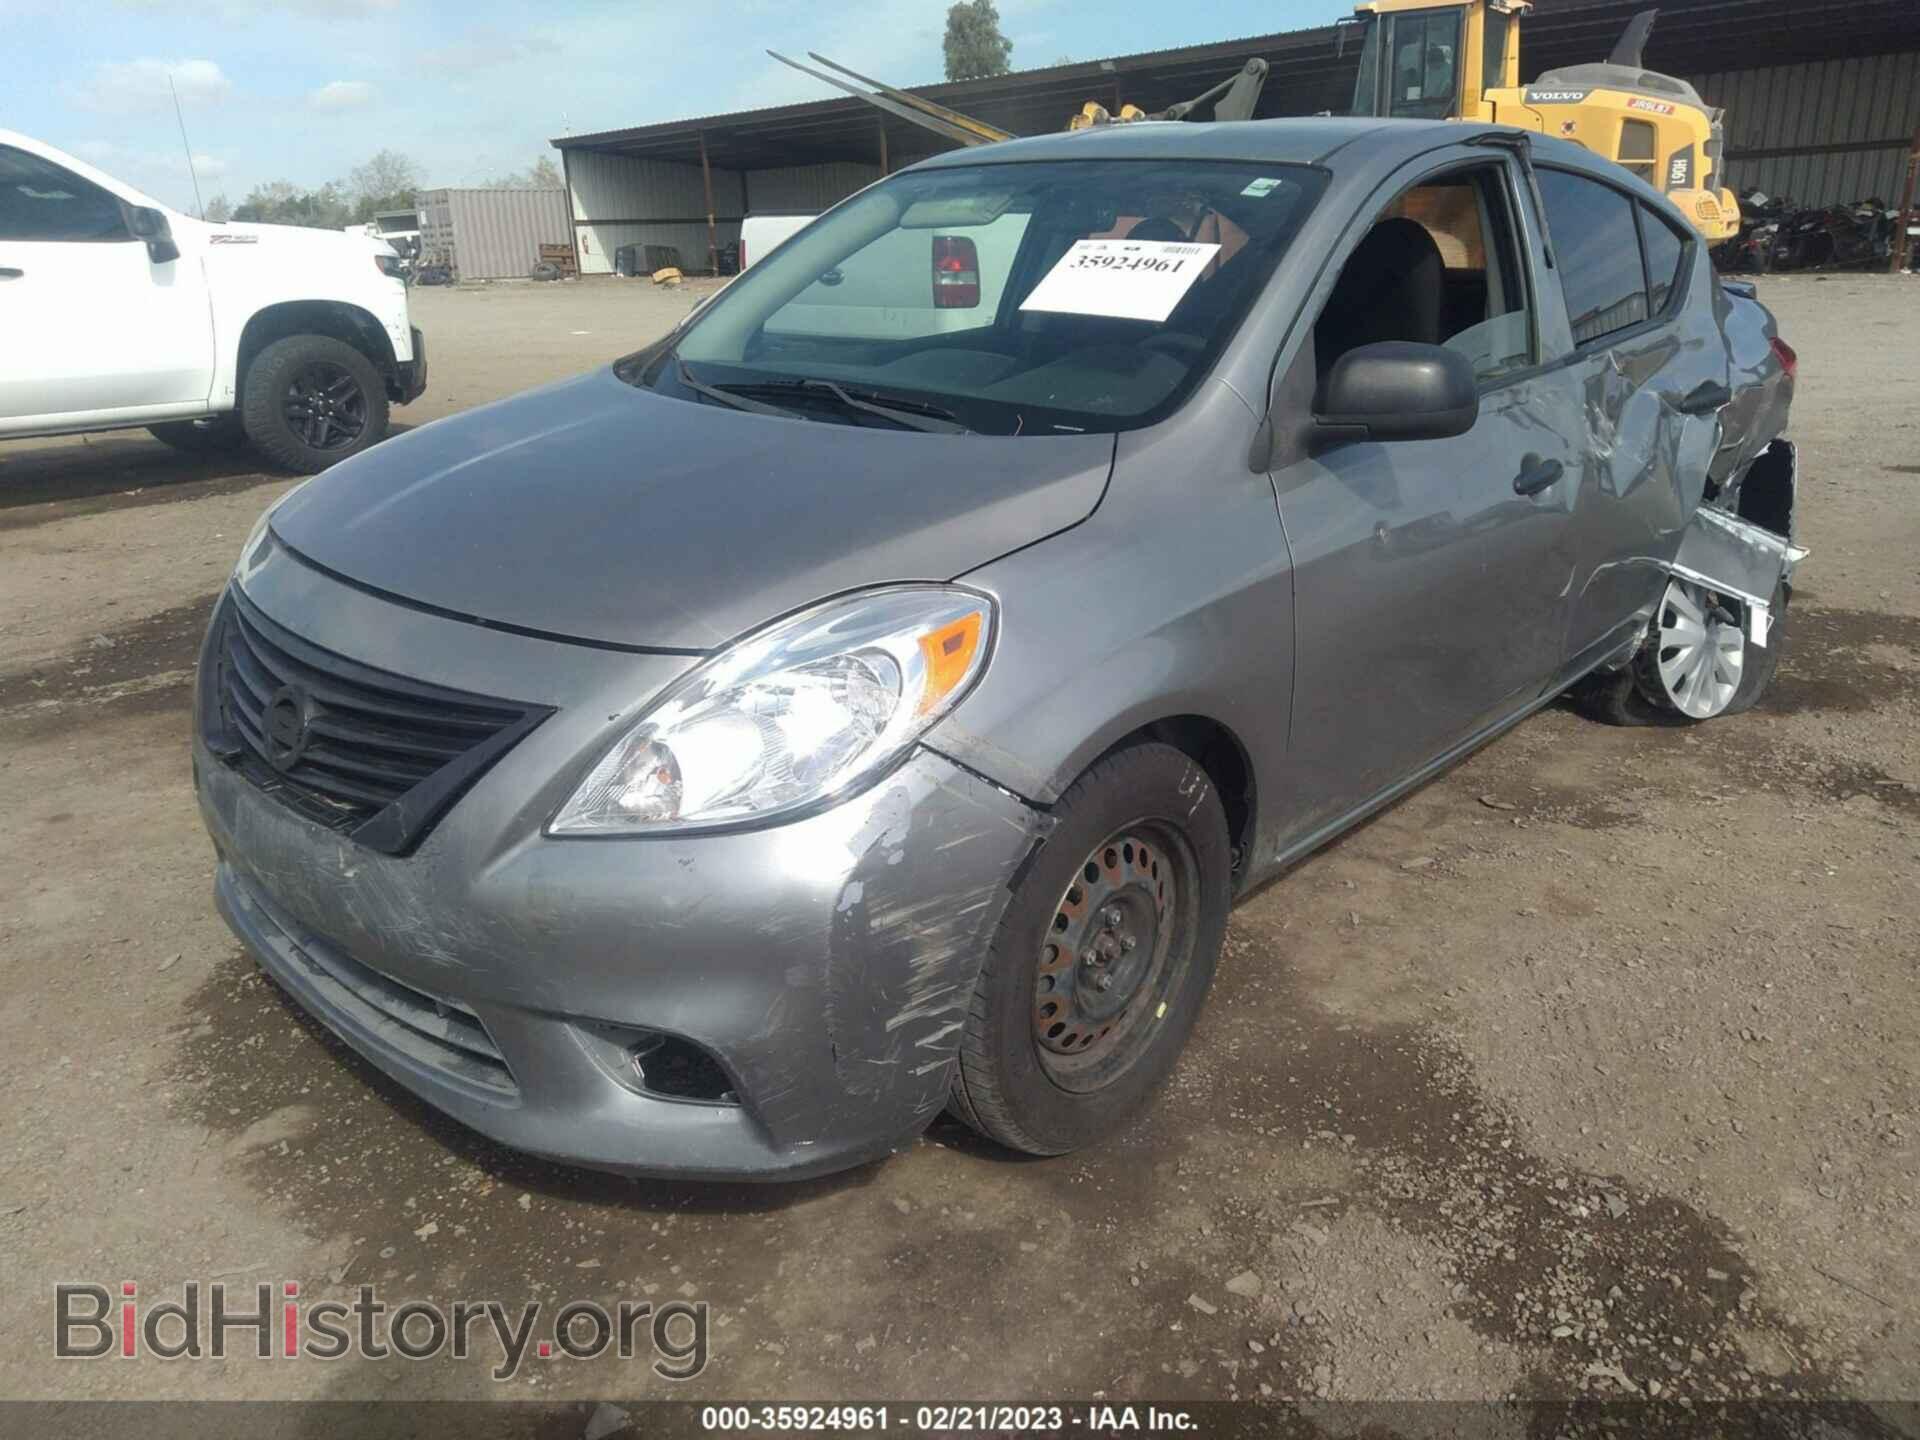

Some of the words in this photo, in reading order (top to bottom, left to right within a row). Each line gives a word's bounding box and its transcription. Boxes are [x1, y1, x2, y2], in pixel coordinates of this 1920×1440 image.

[1531, 91, 1584, 100] VOLVO
[1671, 159, 1688, 184] L90H
[1069, 255, 1185, 272] 35924961
